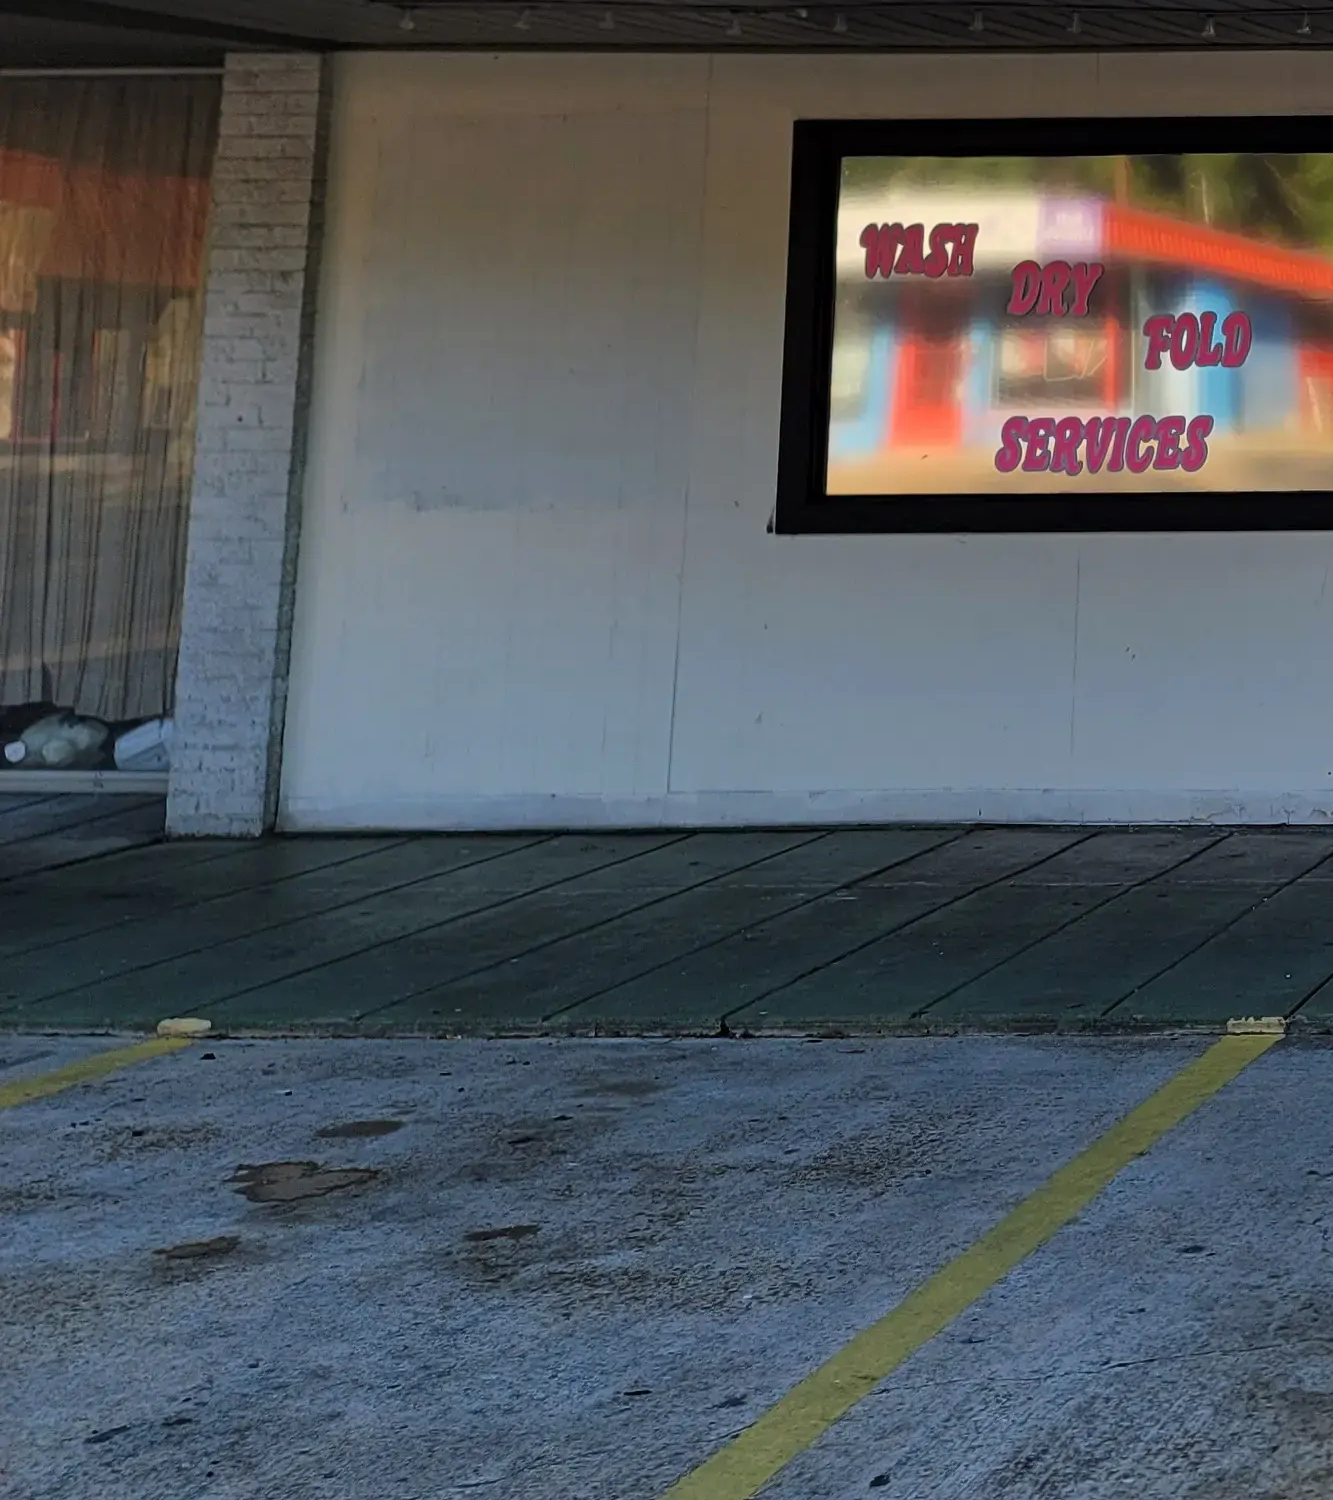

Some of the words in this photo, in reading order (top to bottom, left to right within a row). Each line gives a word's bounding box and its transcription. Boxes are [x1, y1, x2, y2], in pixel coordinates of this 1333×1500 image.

[859, 222, 979, 279] WASH
[1006, 260, 1104, 317] DRY
[1143, 311, 1253, 371] FOLD
[995, 414, 1214, 476] SERVICES
